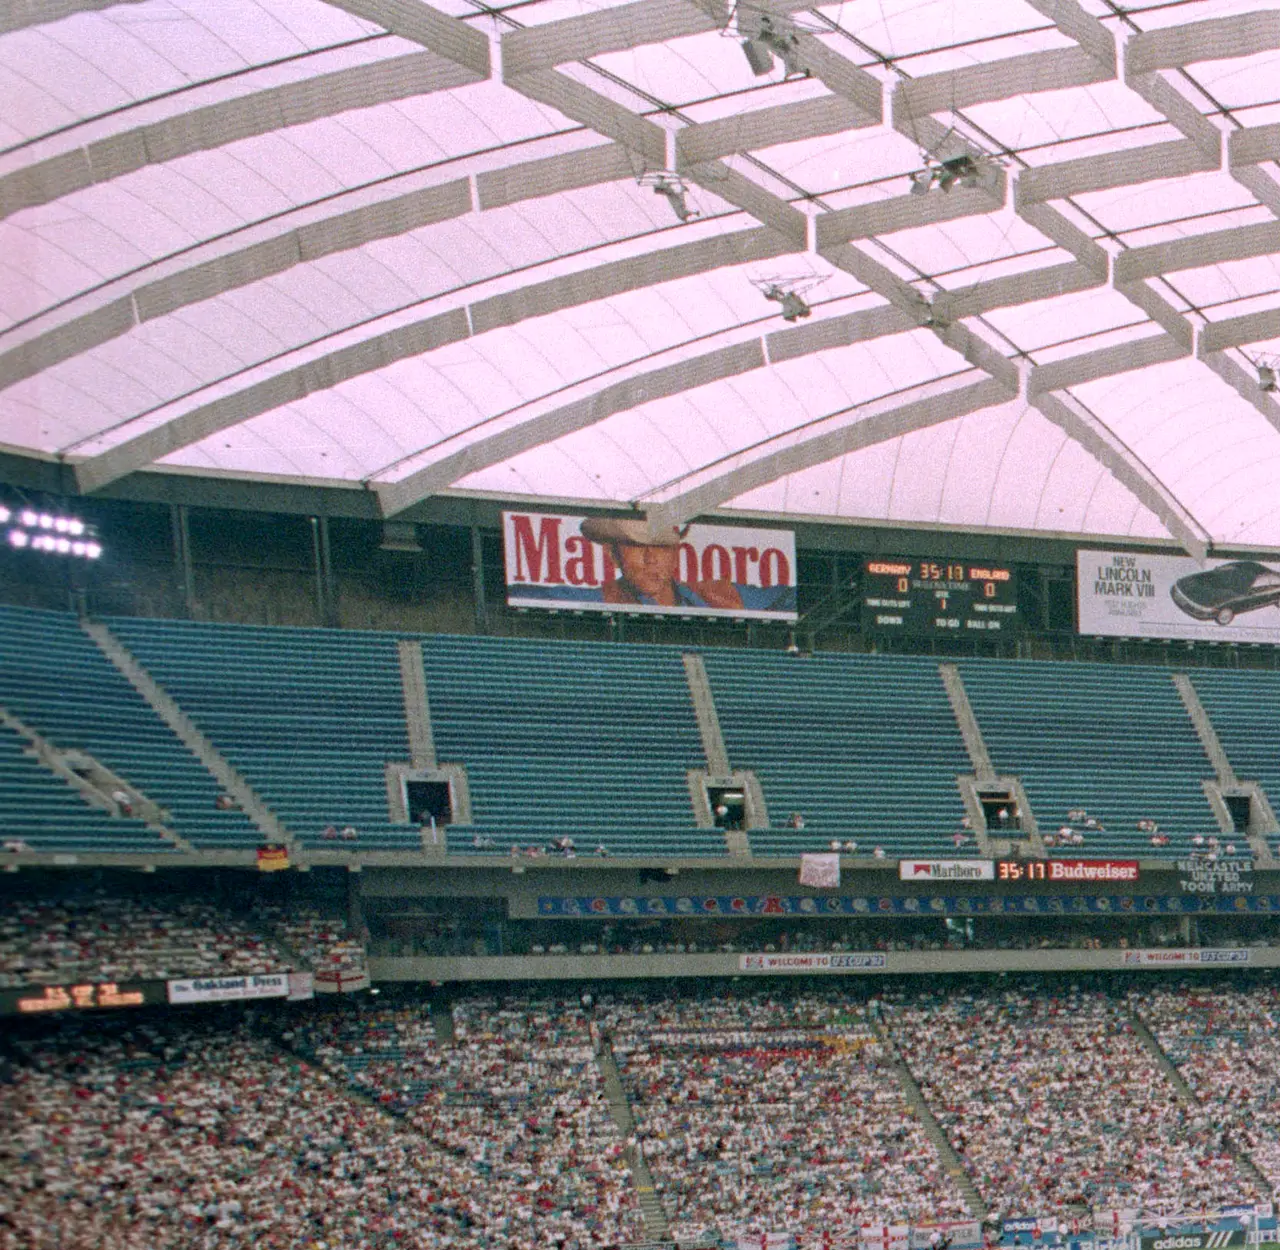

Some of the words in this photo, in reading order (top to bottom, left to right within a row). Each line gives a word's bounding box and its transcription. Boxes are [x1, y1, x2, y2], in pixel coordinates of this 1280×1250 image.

[868, 562, 911, 575] GERMANY
[1112, 556, 1136, 568] NEW
[971, 568, 1009, 580] ENGLAND
[1098, 567, 1151, 581] LINCOLN
[1094, 581, 1132, 597] MARK
[1136, 583, 1155, 597] VIII
[932, 863, 982, 878] Marlboro
[999, 862, 1045, 880] 35:17
[1051, 862, 1137, 880] Budweiser
[1178, 860, 1253, 873] NEWCASTLE
[1192, 872, 1240, 882] UNITED
[1180, 880, 1215, 893] TOON
[1222, 882, 1253, 893] ARMY
[768, 957, 813, 966] WELCOME
[816, 957, 828, 966] TO
[1189, 952, 1199, 960] TO
[192, 976, 248, 990] Oakland
[252, 975, 282, 988] Press
[1004, 1221, 1036, 1232] adidas
[1153, 1237, 1201, 1250] adidas
